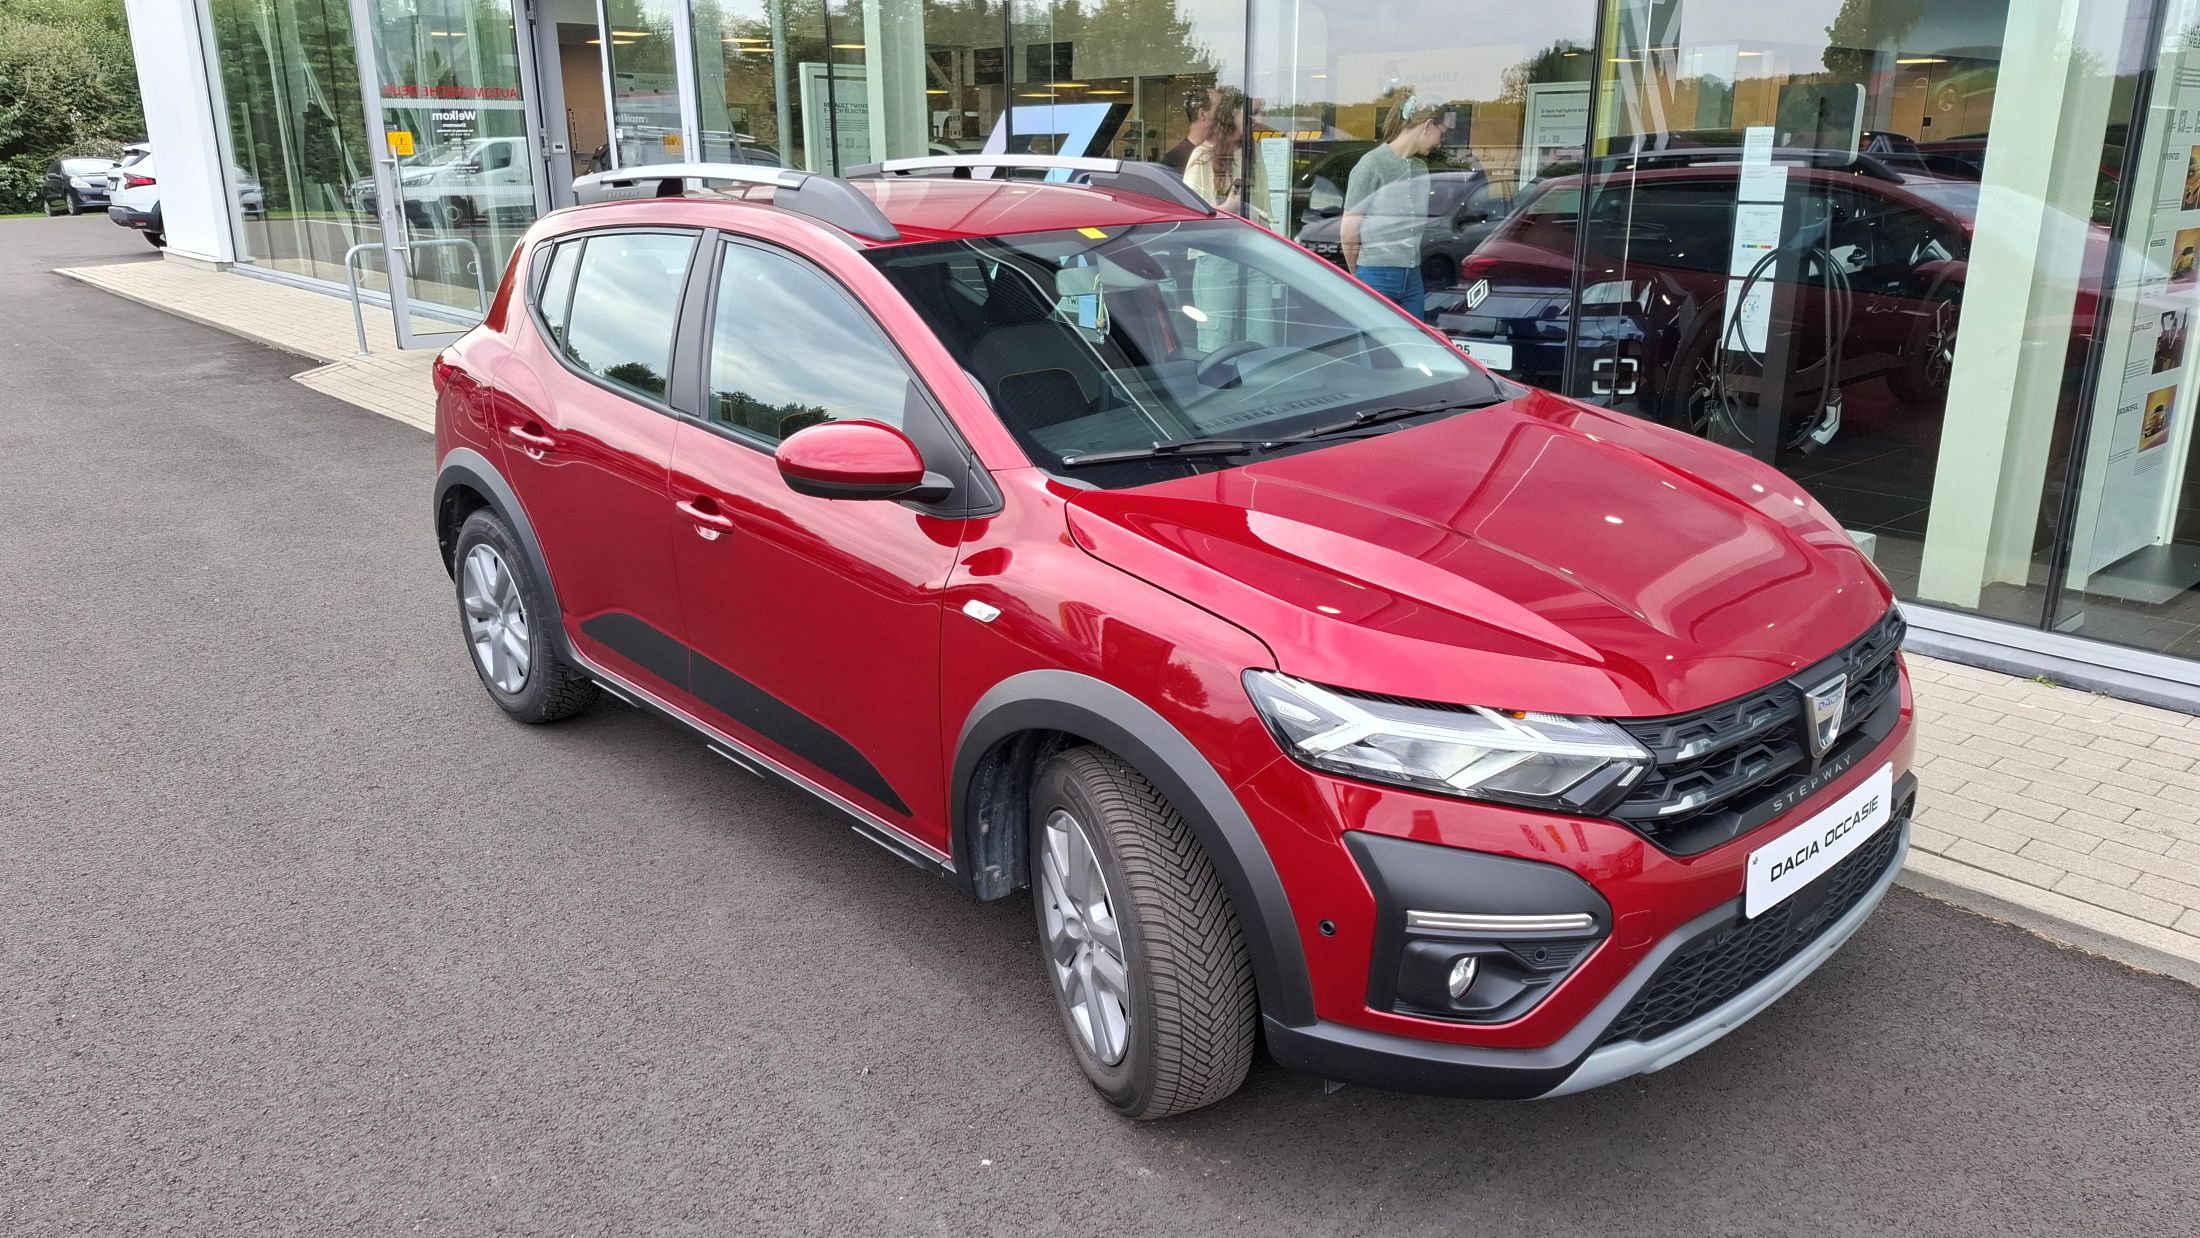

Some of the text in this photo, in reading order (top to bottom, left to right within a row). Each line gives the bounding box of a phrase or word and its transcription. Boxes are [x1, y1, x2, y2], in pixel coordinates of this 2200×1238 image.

[1817, 690, 1843, 711] DACIA
[1772, 754, 1852, 812] STEPWAY
[1770, 794, 1879, 883] DACIA OCCASIE
